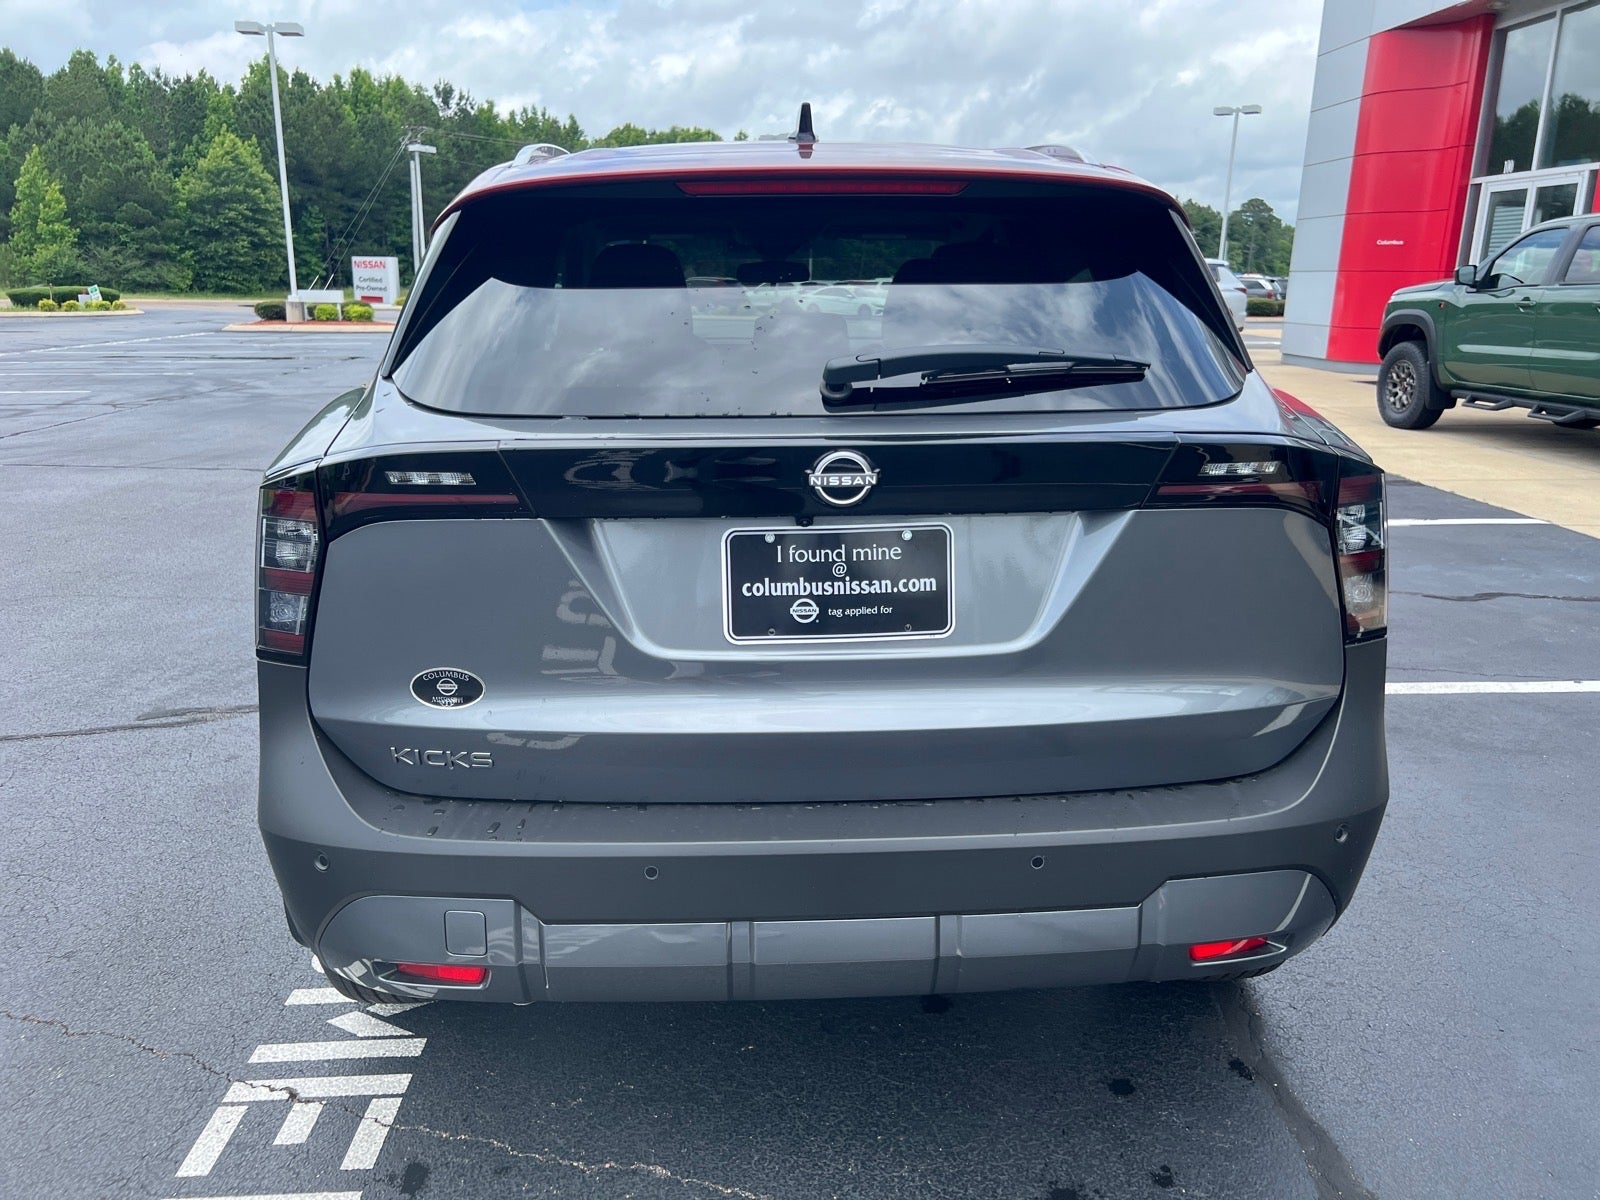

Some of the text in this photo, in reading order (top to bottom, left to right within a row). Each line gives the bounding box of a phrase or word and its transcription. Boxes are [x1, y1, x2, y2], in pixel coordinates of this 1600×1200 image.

[354, 260, 386, 269] NISSAN
[358, 276, 383, 284] Certified
[355, 285, 388, 293] Pre-Owned
[810, 475, 877, 486] NISSAN
[776, 543, 902, 563] I found mine
[832, 562, 847, 578] @
[741, 576, 937, 598] columbusnissan.com
[827, 605, 893, 618] tag applied for
[422, 670, 470, 682] COLUMBUS
[389, 747, 495, 769] KICKS
